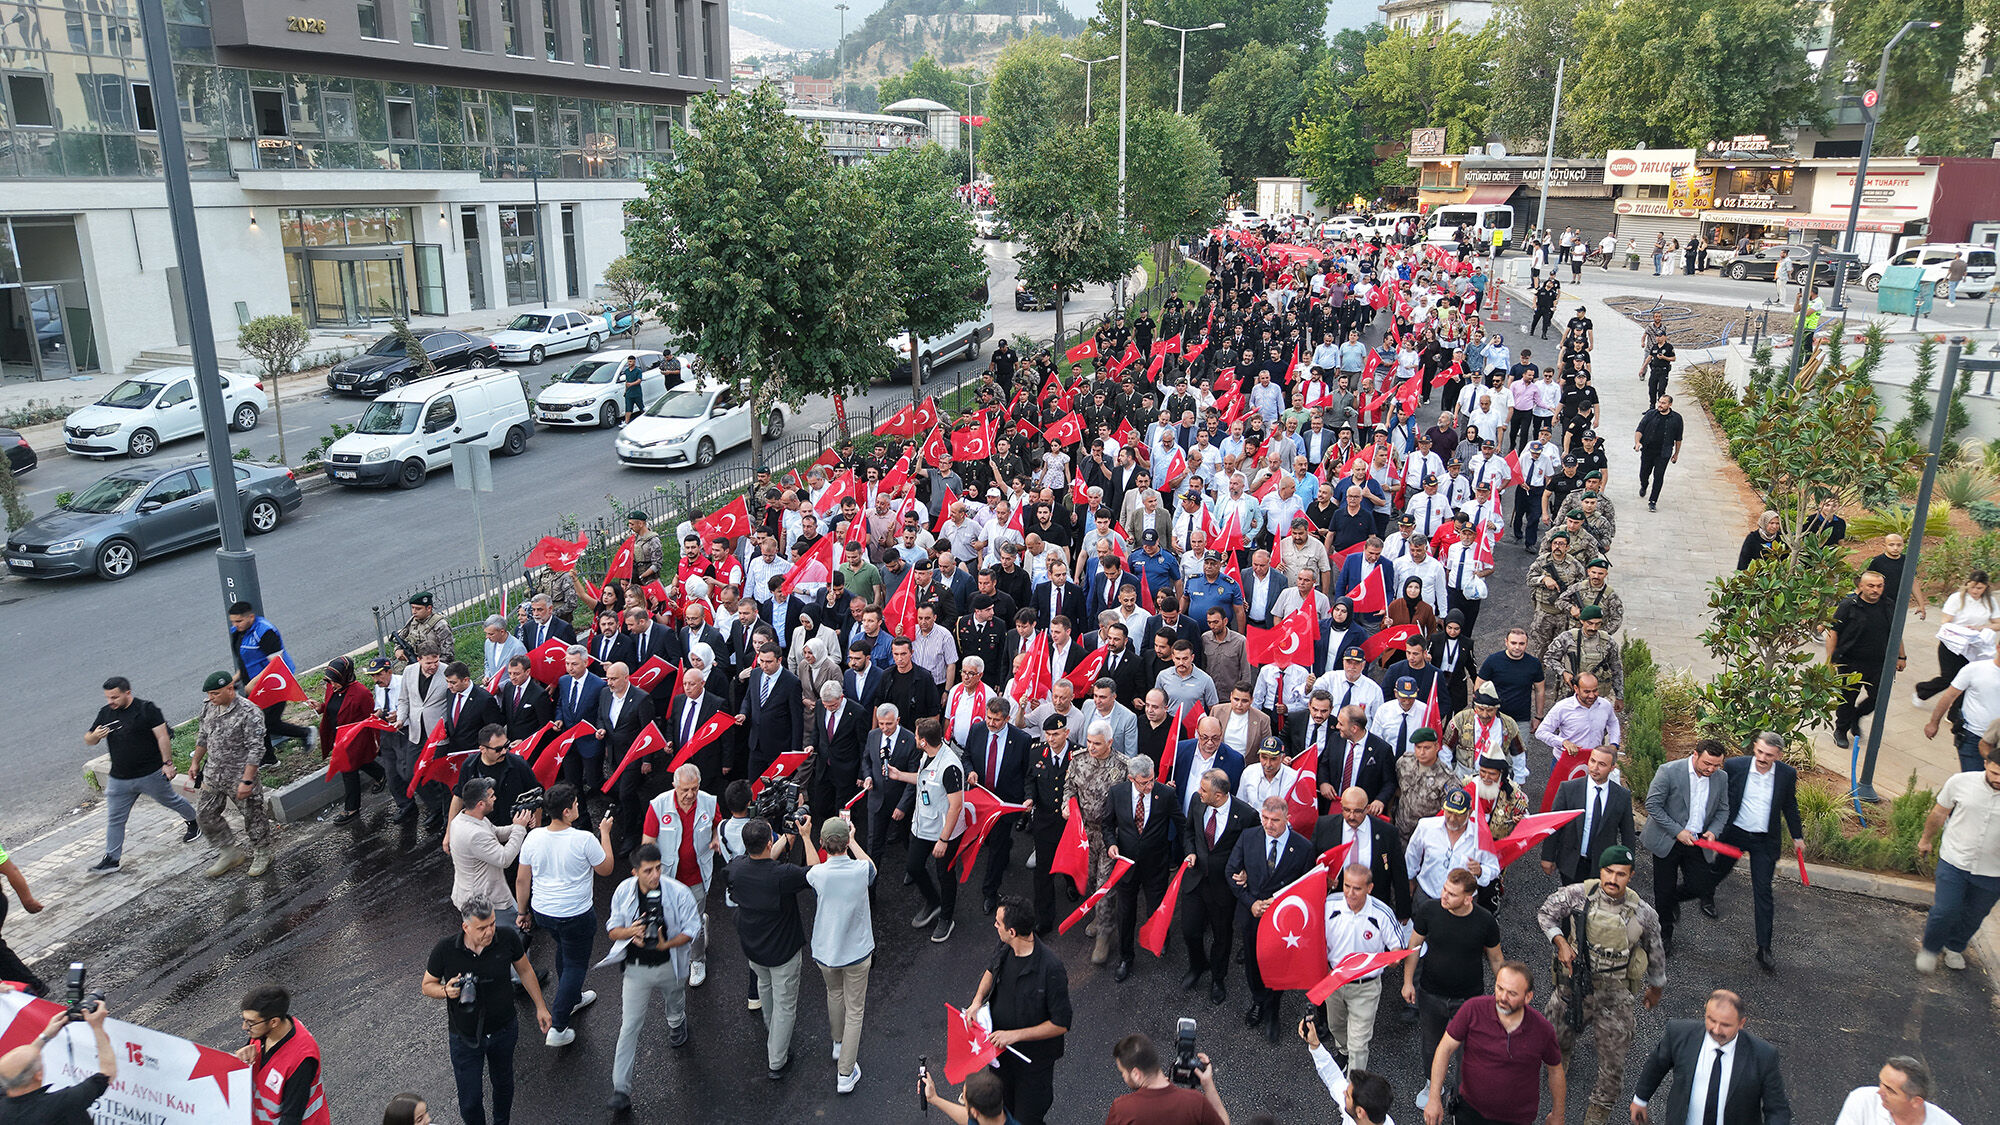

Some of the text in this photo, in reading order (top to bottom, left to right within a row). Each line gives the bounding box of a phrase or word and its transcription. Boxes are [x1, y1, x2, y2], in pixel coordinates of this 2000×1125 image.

[288, 15, 327, 34] 2026
[1717, 141, 1730, 151] ÖZ
[1731, 142, 1770, 151] LEZZET
[1548, 167, 1587, 181] KÜTÜKÇÜ
[1849, 177, 1909, 187] ÖZEM TUHAFİYE
[1673, 199, 1684, 208] 95
[1692, 198, 1708, 207] 200
[1723, 196, 1737, 208] ÖZ
[1737, 199, 1775, 209] LEZZET
[108, 1080, 129, 1096] AN,
[131, 1083, 163, 1105] AYNI
[166, 1093, 195, 1115] KAN
[104, 1097, 168, 1125] TEMMUZ
